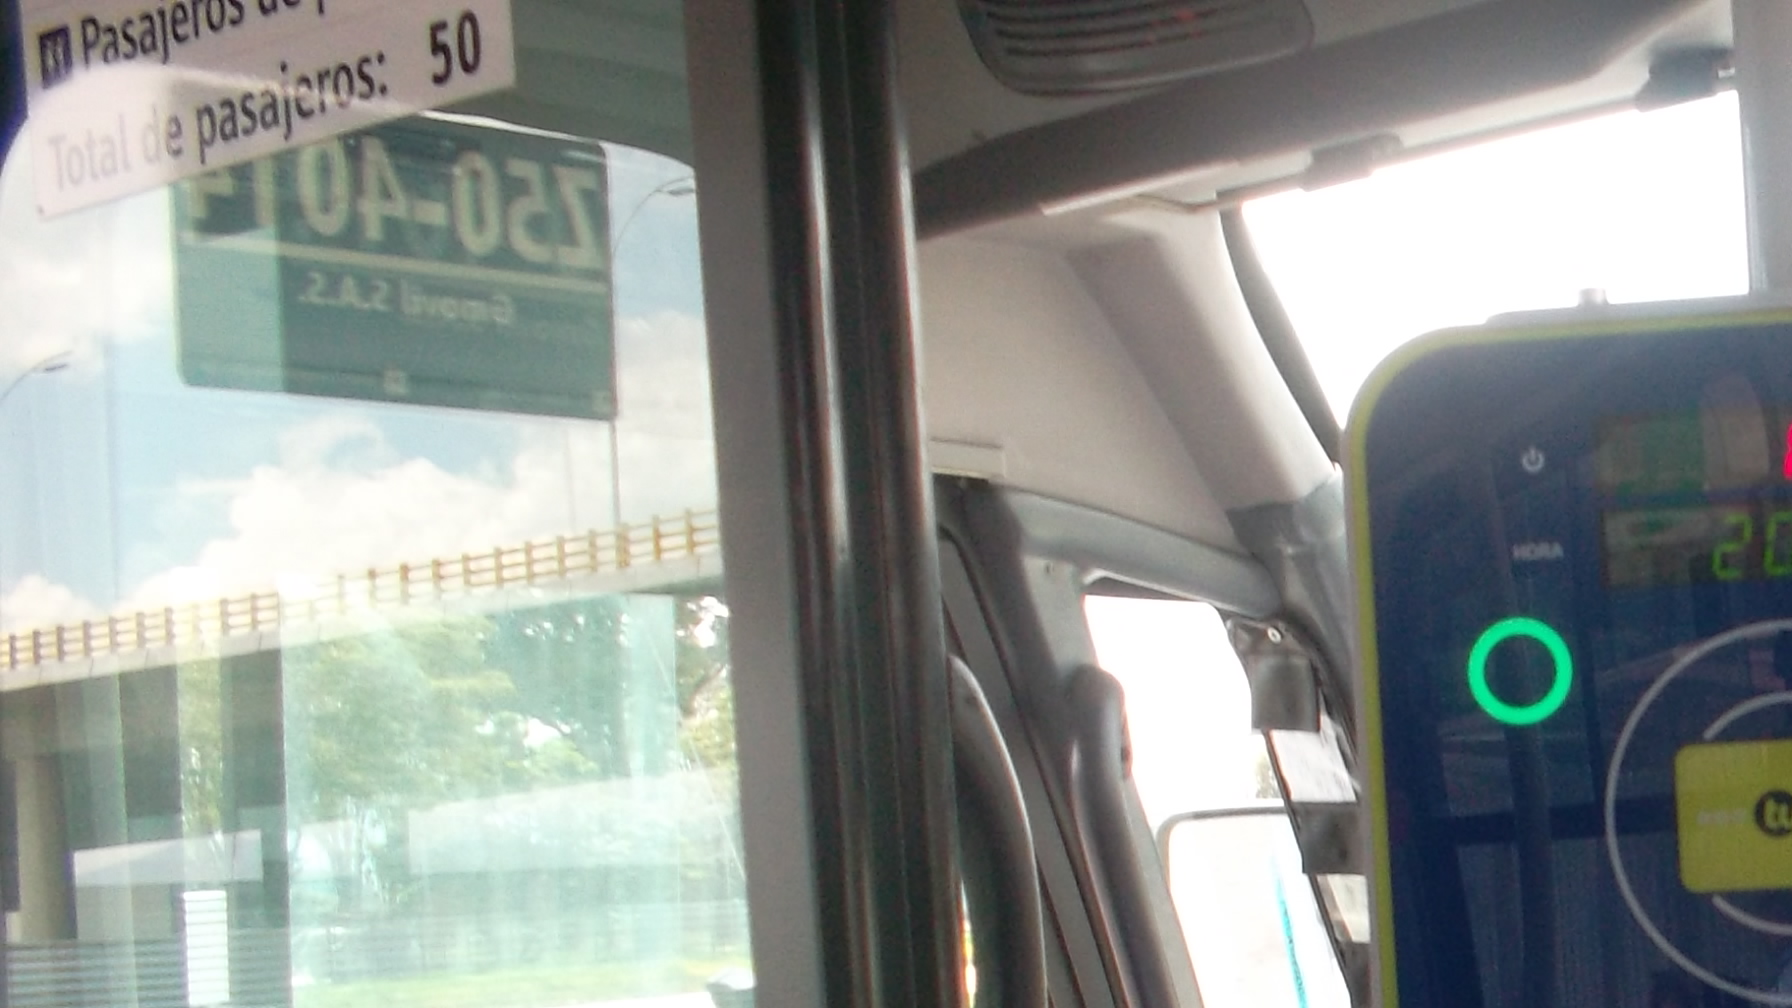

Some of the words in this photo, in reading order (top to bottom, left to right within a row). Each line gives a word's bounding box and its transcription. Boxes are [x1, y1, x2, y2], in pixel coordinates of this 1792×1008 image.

[48, 112, 133, 191] Total
[142, 105, 183, 157] de
[196, 51, 388, 164] pasajeros:
[429, 8, 481, 86] 50
[1512, 541, 1564, 560] HORA
